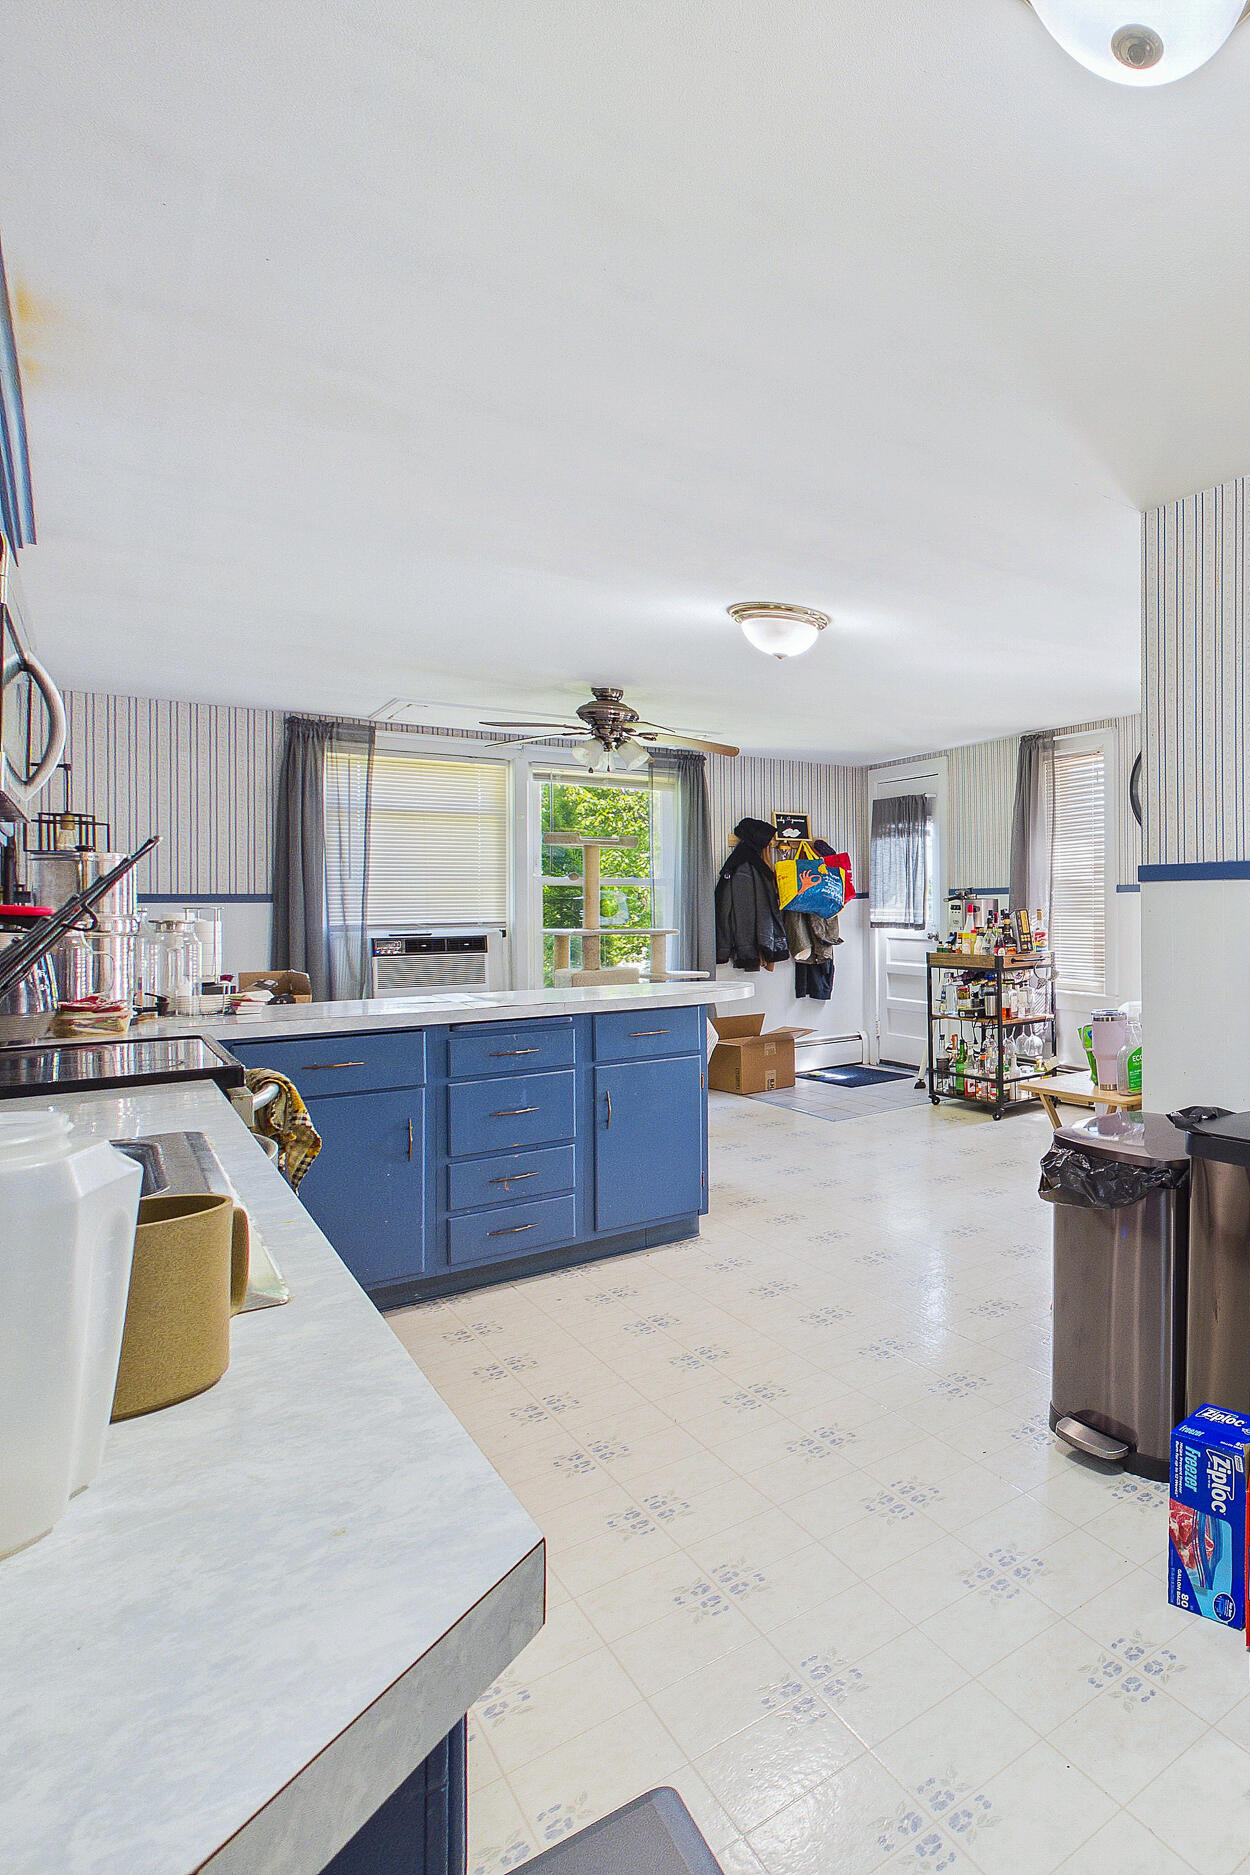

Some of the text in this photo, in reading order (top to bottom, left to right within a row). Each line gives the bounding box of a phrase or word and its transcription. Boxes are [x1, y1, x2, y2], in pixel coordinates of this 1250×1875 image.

[1200, 1408, 1245, 1428] Ziploc
[1184, 1445, 1201, 1493] Freezer
[1207, 1456, 1232, 1514] Ziploc
[1181, 1593, 1189, 1608] 80
